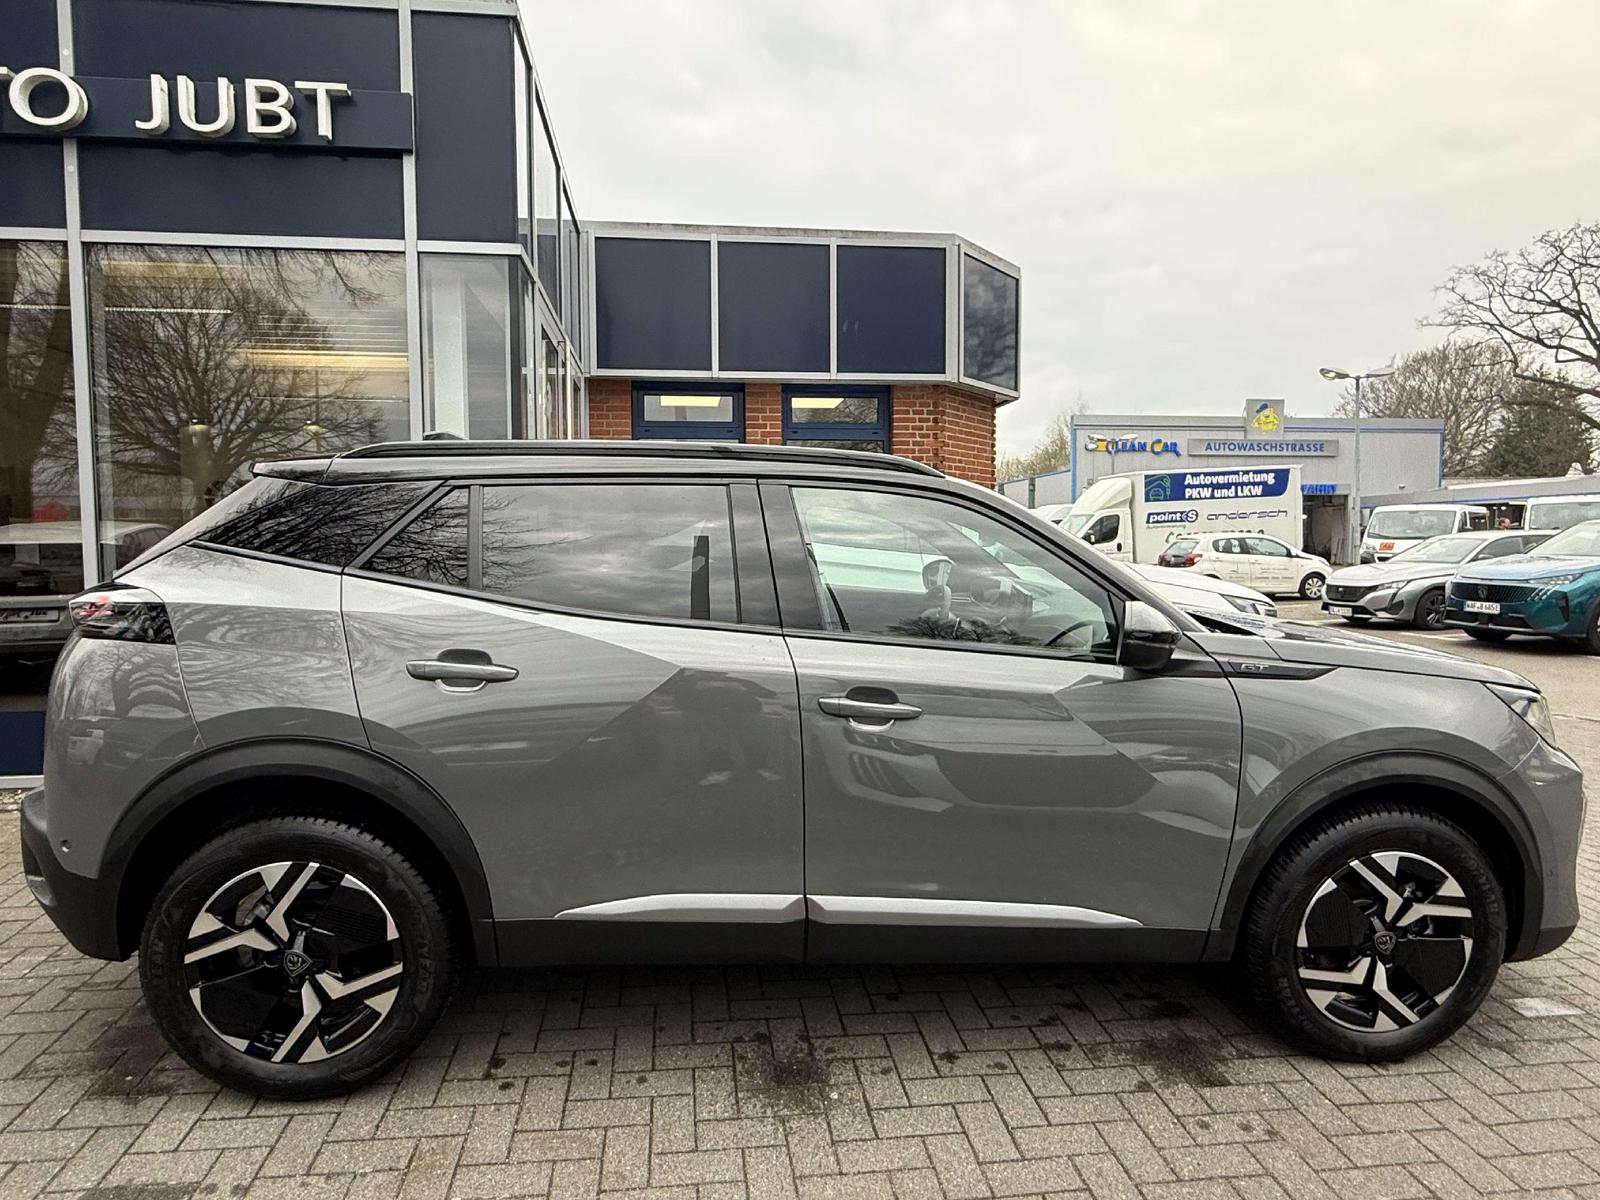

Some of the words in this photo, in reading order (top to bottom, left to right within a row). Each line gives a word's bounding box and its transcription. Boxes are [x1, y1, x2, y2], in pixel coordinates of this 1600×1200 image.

[0, 66, 88, 131] O
[135, 73, 351, 140] JUBT
[1151, 438, 1182, 457] CAR
[1205, 442, 1325, 452] AUTOWASCHSTRASSE
[1184, 472, 1276, 485] Autovermietung
[1185, 487, 1213, 499] PKW
[1214, 486, 1236, 498] und
[1237, 485, 1263, 497] LKW
[1149, 511, 1182, 523] point
[1206, 509, 1288, 520] andersch
[1241, 663, 1269, 672] GT
